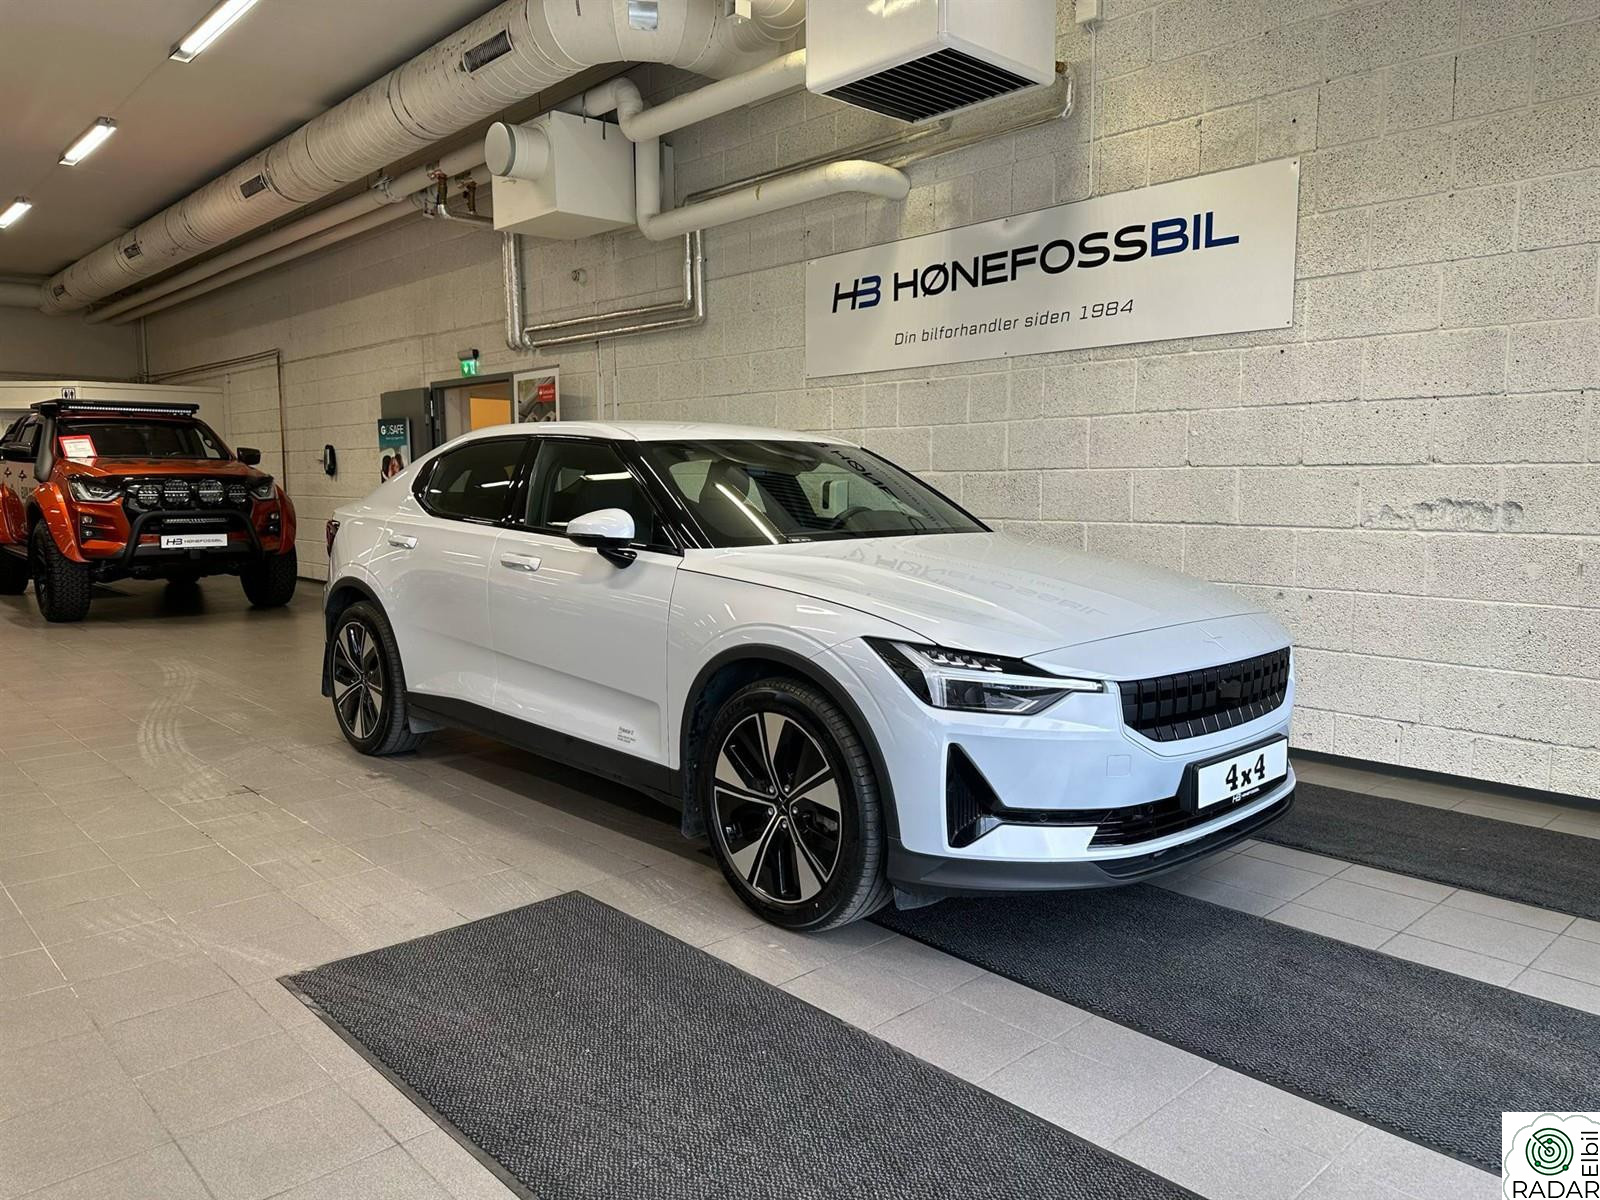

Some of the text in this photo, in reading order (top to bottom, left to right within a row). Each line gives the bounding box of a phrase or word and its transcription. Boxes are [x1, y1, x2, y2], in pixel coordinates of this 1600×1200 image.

[893, 211, 1240, 302] HØNEFOSSBIL
[894, 299, 1135, 346] Din bilforhandler siden 1984
[1225, 753, 1266, 792] 4x4
